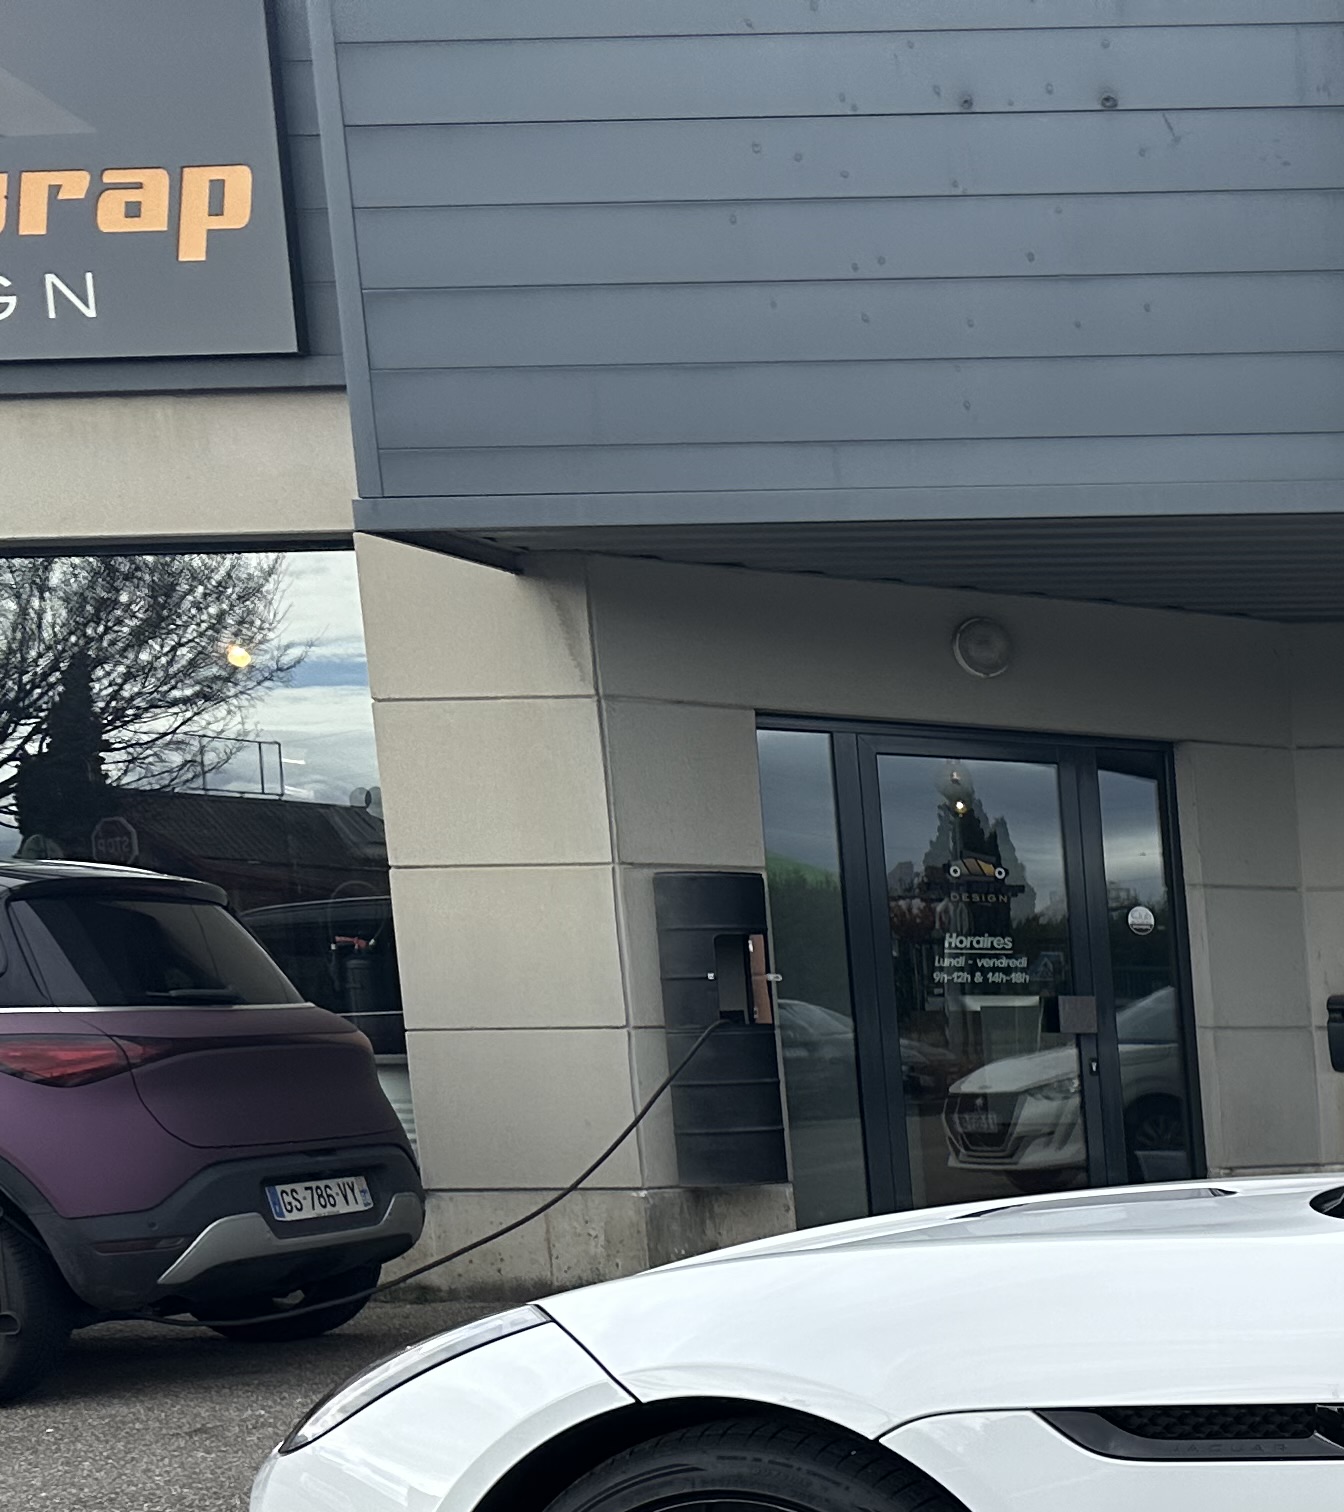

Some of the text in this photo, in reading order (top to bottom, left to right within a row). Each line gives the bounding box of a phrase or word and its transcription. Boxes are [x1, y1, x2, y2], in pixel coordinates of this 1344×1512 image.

[0, 164, 253, 262] rap
[950, 892, 1008, 903] DESIGN
[944, 932, 1013, 949] Horaires
[934, 956, 966, 967] Lundi
[976, 956, 1028, 968] vendredi
[933, 972, 1030, 983] 9h-12h & 14h-18h
